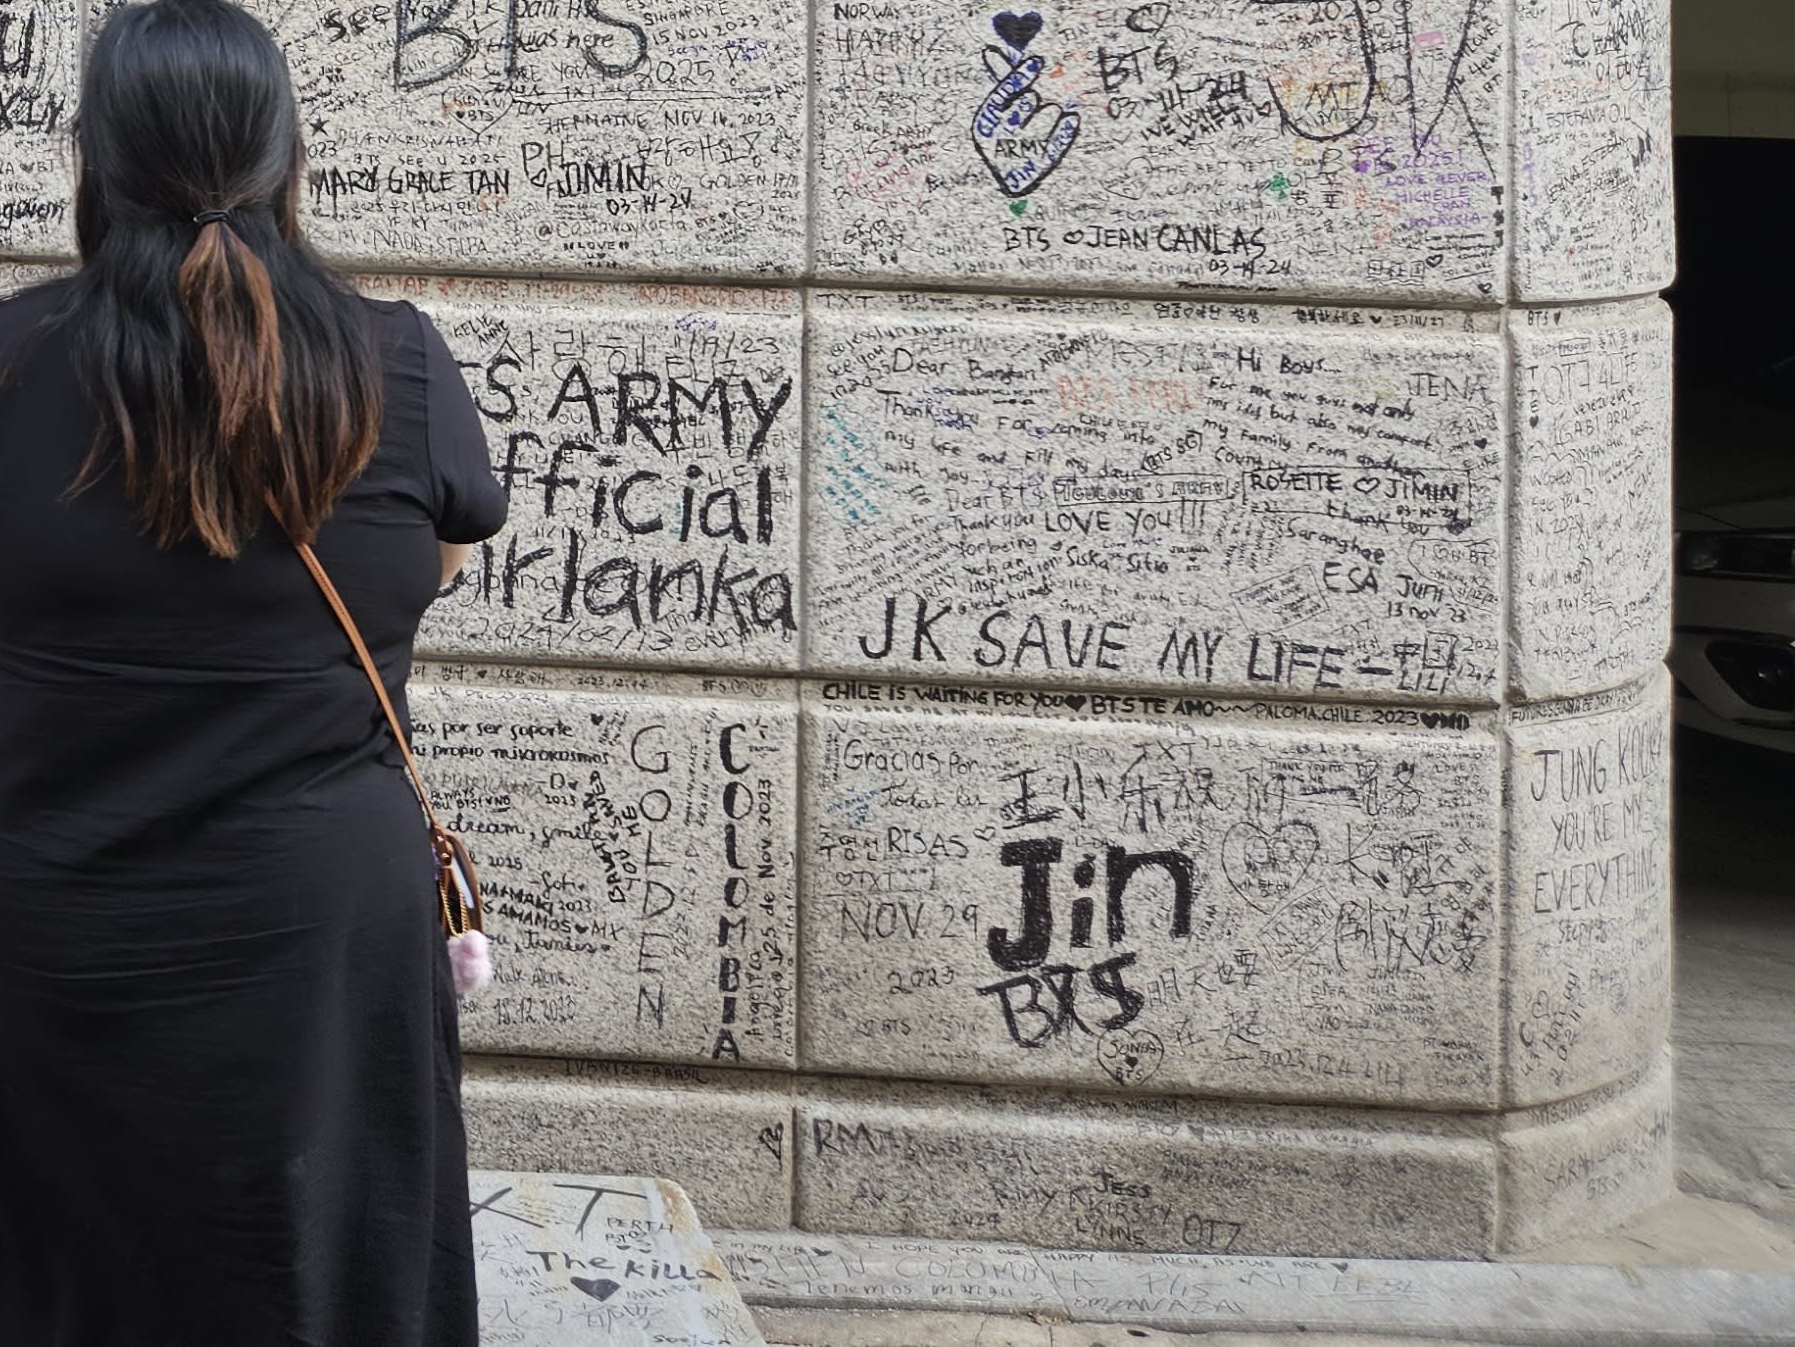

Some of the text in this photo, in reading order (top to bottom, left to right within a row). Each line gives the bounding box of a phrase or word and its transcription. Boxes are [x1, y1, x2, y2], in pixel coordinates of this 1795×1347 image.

[834, 2, 902, 22] NORWAY
[1100, 45, 1187, 94] BTS
[537, 112, 655, 136] SHERMAINE
[386, 165, 511, 198] GRACE TAN
[1004, 224, 1269, 257] BTS JEAN CANLAS
[889, 348, 951, 380] Dear
[1407, 372, 1489, 403] JENA
[547, 362, 794, 461] ARMY
[1249, 472, 1345, 496] ROSETTE
[1043, 508, 1111, 534] LOVE
[858, 594, 1348, 692] JK SAVE MY LIFE
[992, 688, 1215, 719] FOR YOU BTS TE AMO
[843, 736, 941, 778] Gracias
[1529, 738, 1607, 803] JUNG
[884, 823, 969, 858] RISAS
[1549, 801, 1615, 855] YOU'RE
[1532, 840, 1660, 915] EVERYTHING
[984, 835, 1196, 973] Jin
[975, 951, 1145, 1050] BTS
[525, 1249, 617, 1276] The
